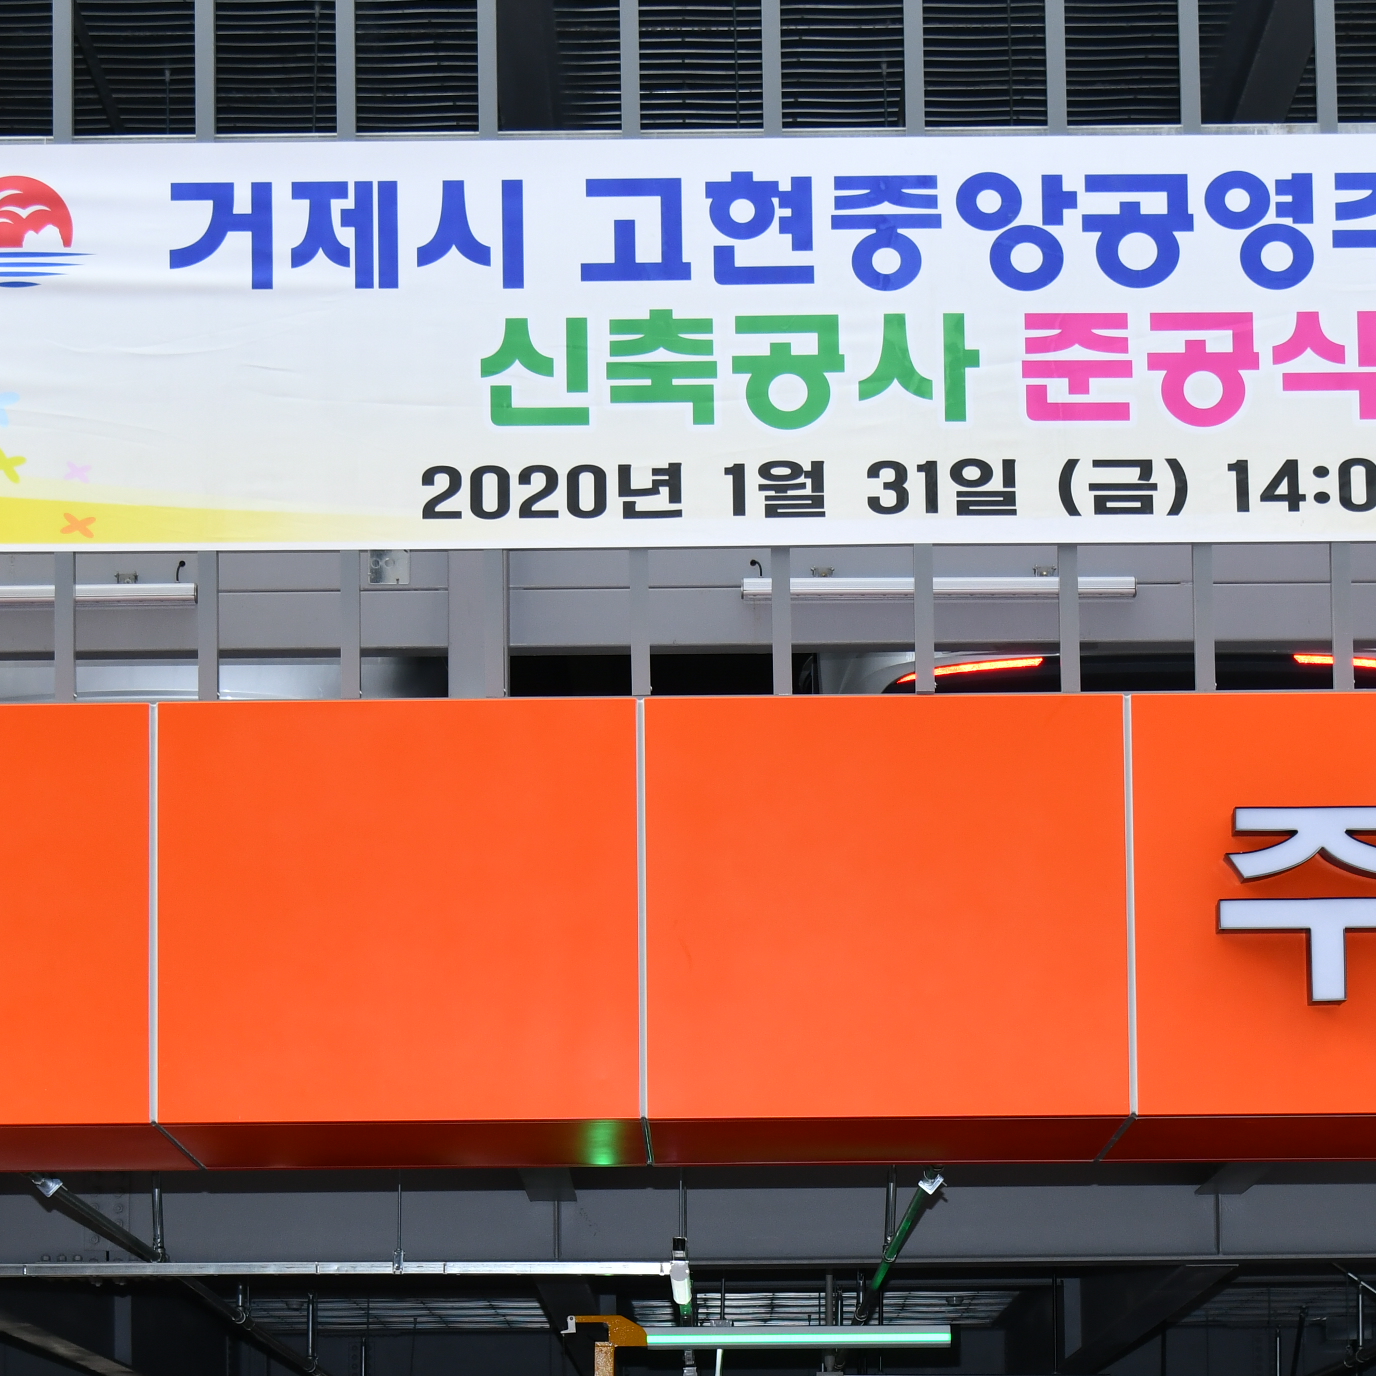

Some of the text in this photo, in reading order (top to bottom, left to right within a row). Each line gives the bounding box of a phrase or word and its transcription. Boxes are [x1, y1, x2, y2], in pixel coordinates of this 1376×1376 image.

[169, 178, 524, 290] 거제시
[481, 309, 979, 428] 신축공사
[421, 462, 683, 520] 2020년
[724, 460, 826, 519] 1월
[866, 458, 1017, 517] 31일
[1058, 457, 1188, 517] (금)
